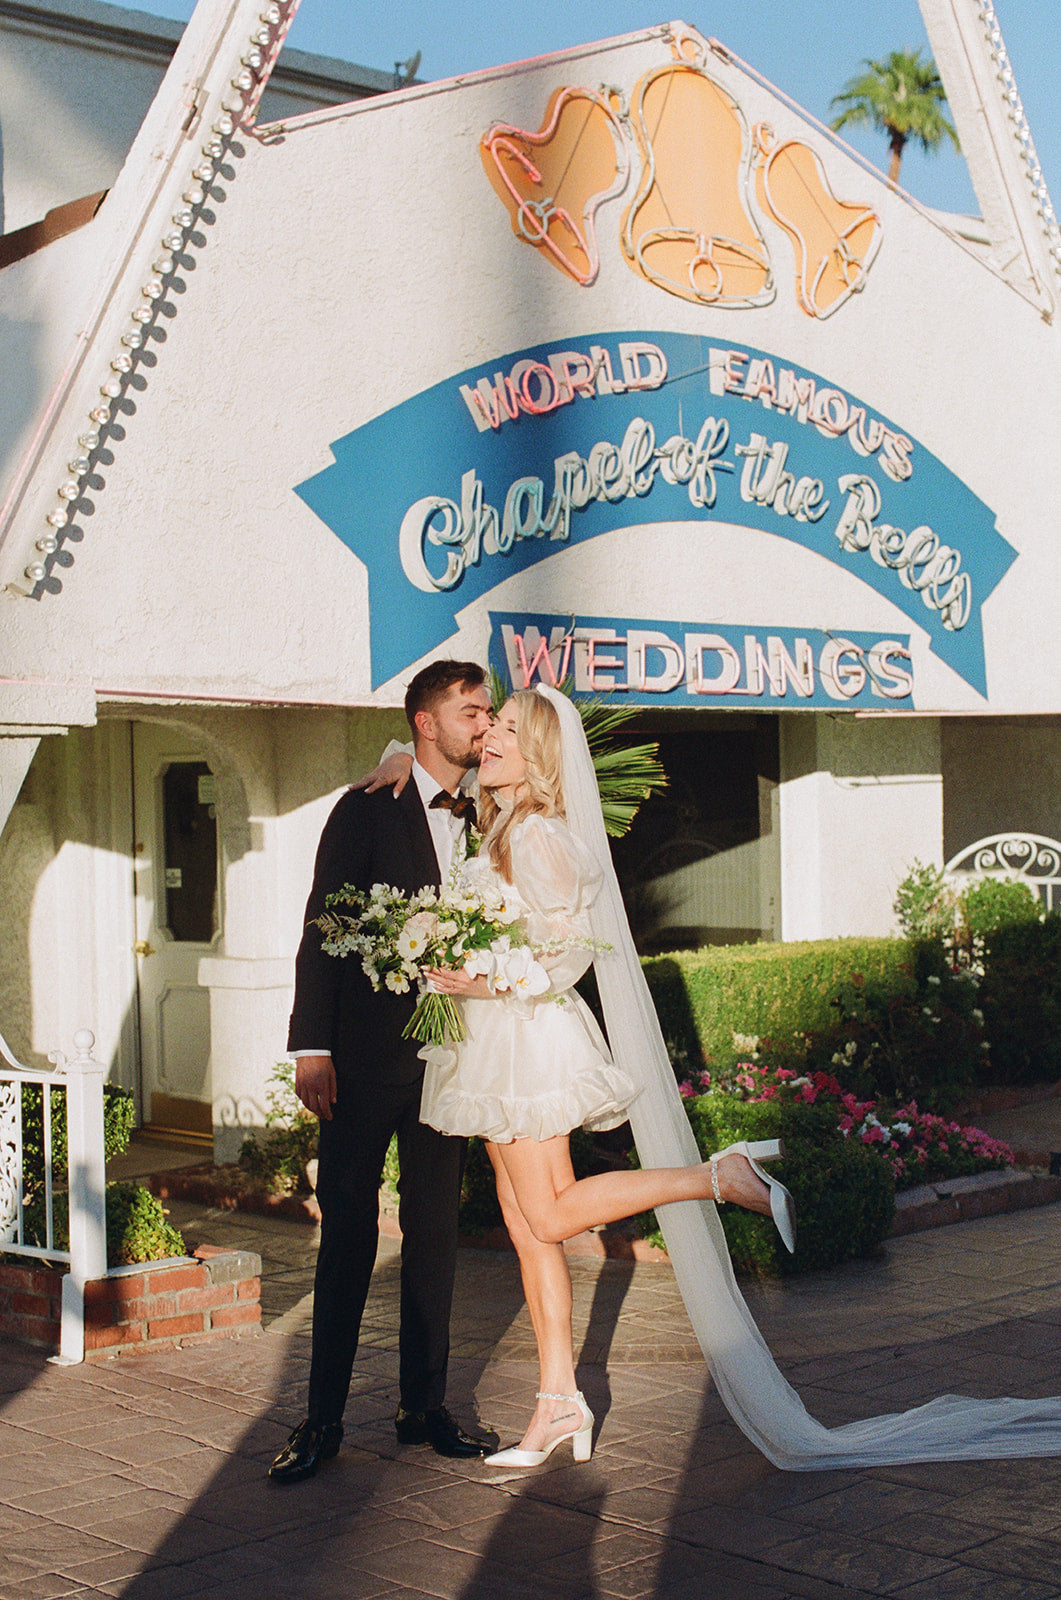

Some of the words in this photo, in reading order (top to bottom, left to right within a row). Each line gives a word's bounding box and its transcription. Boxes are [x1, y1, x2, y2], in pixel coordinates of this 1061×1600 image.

[459, 342, 667, 432] WORLD
[709, 348, 914, 481] FAMOUS
[399, 417, 655, 593] Chapel
[660, 417, 734, 508] of
[735, 433, 830, 522] the
[835, 473, 971, 631] Bells
[501, 624, 913, 700] WEDDINGS
